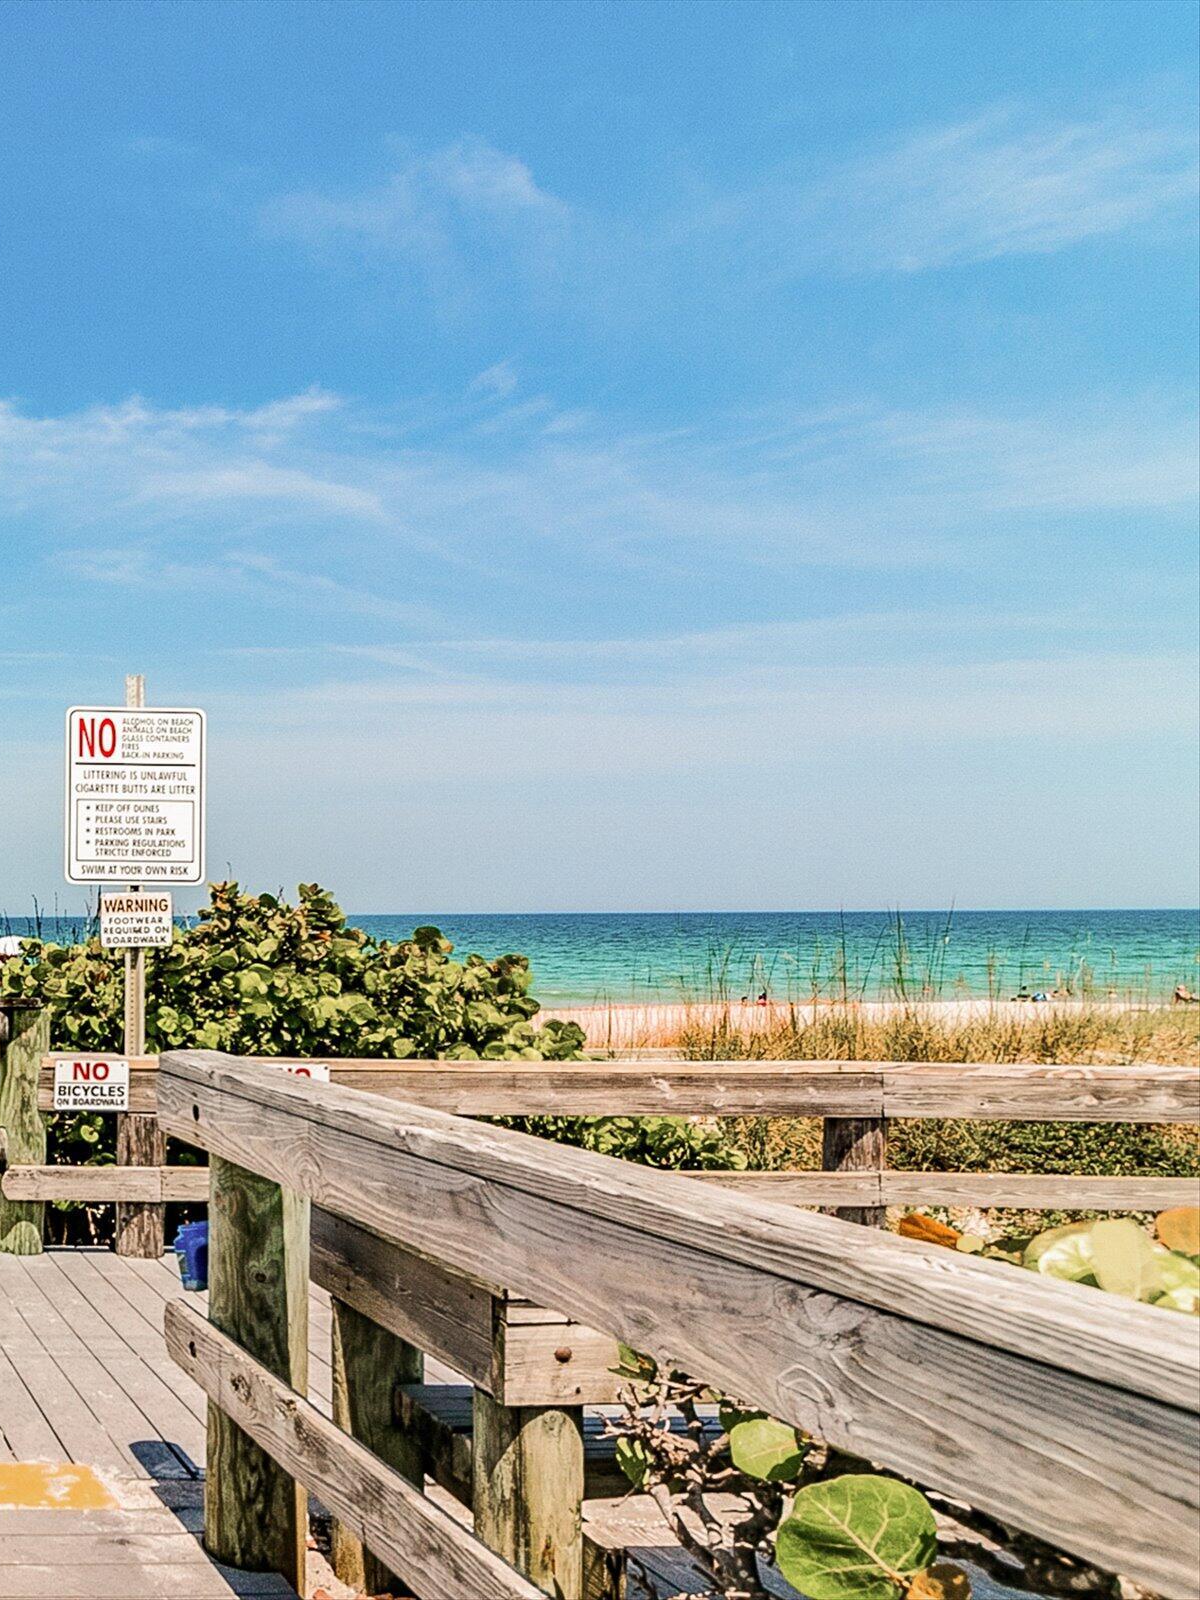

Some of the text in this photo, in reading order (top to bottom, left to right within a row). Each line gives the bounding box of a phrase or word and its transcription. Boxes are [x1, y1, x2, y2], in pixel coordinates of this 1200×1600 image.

[79, 718, 116, 757] NO
[84, 771, 187, 781] LITTERING IS UNLAWFUL
[76, 784, 195, 795] CIGARETTE BUTTS ARE LITTER
[134, 805, 159, 813] DUNES
[156, 828, 176, 836] PARK
[95, 839, 129, 847] PARKING
[132, 849, 171, 857] ENFORCED
[82, 866, 188, 875] SWIM AT YOUR OWN RISK
[104, 899, 169, 913] WARNING
[108, 916, 163, 925] FOOTWEAR
[103, 926, 169, 934] REQUIRED ON
[106, 936, 167, 944] BOARDWALK
[73, 1062, 109, 1080] NO
[58, 1085, 125, 1097] BICYCLES
[57, 1098, 125, 1106] ON BOARDWALK
